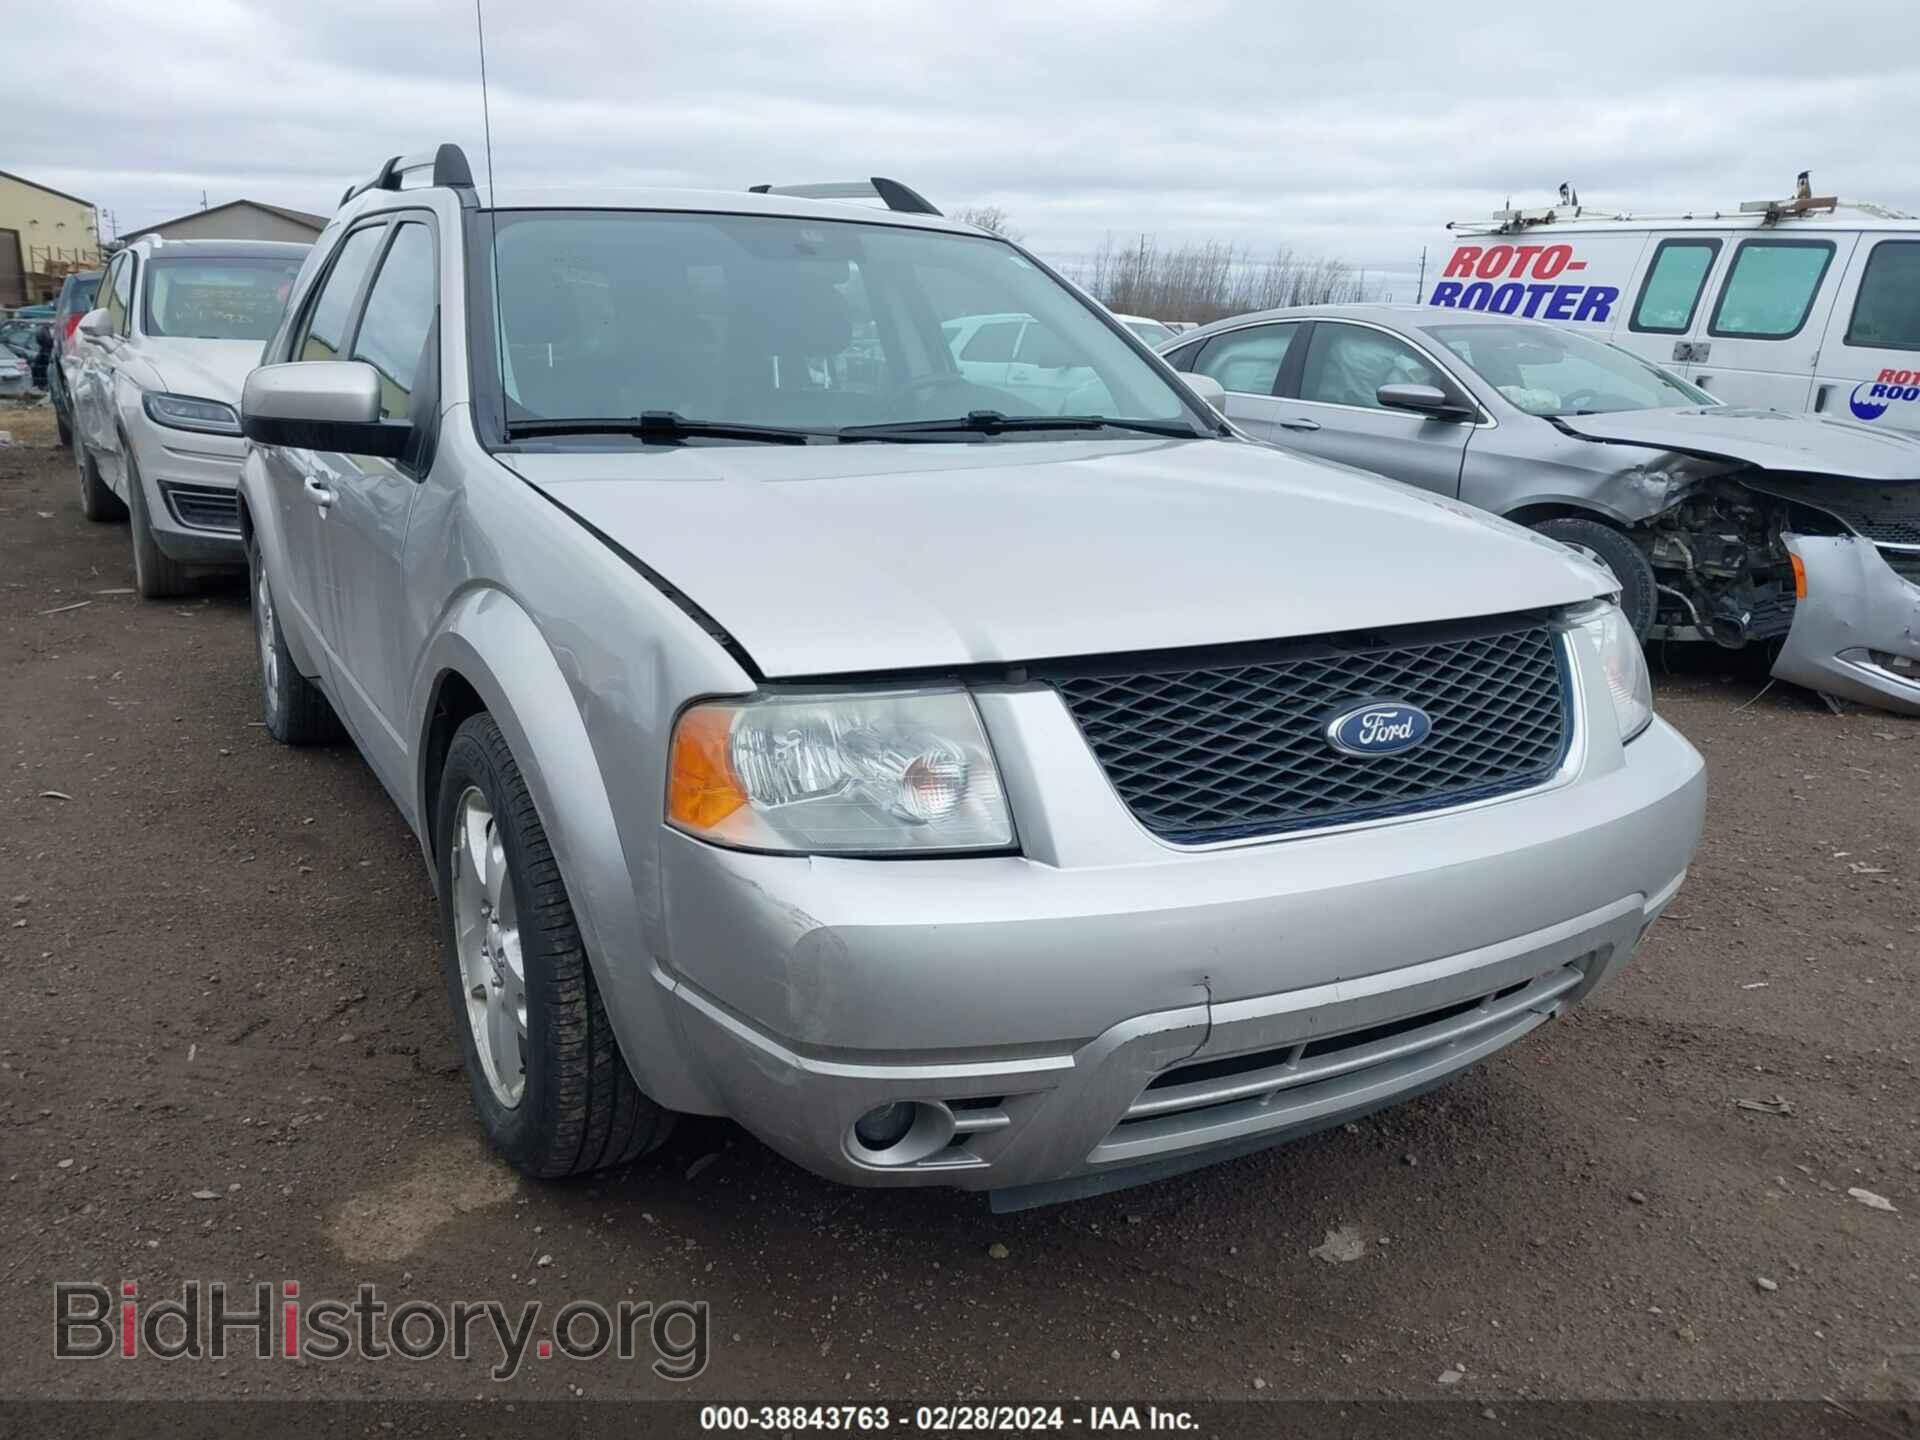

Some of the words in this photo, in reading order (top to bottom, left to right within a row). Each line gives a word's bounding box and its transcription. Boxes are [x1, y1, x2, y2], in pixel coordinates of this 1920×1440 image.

[1443, 245, 1587, 279] ROTO-
[1430, 282, 1619, 322] ROOTER
[1360, 712, 1414, 744] Ford
